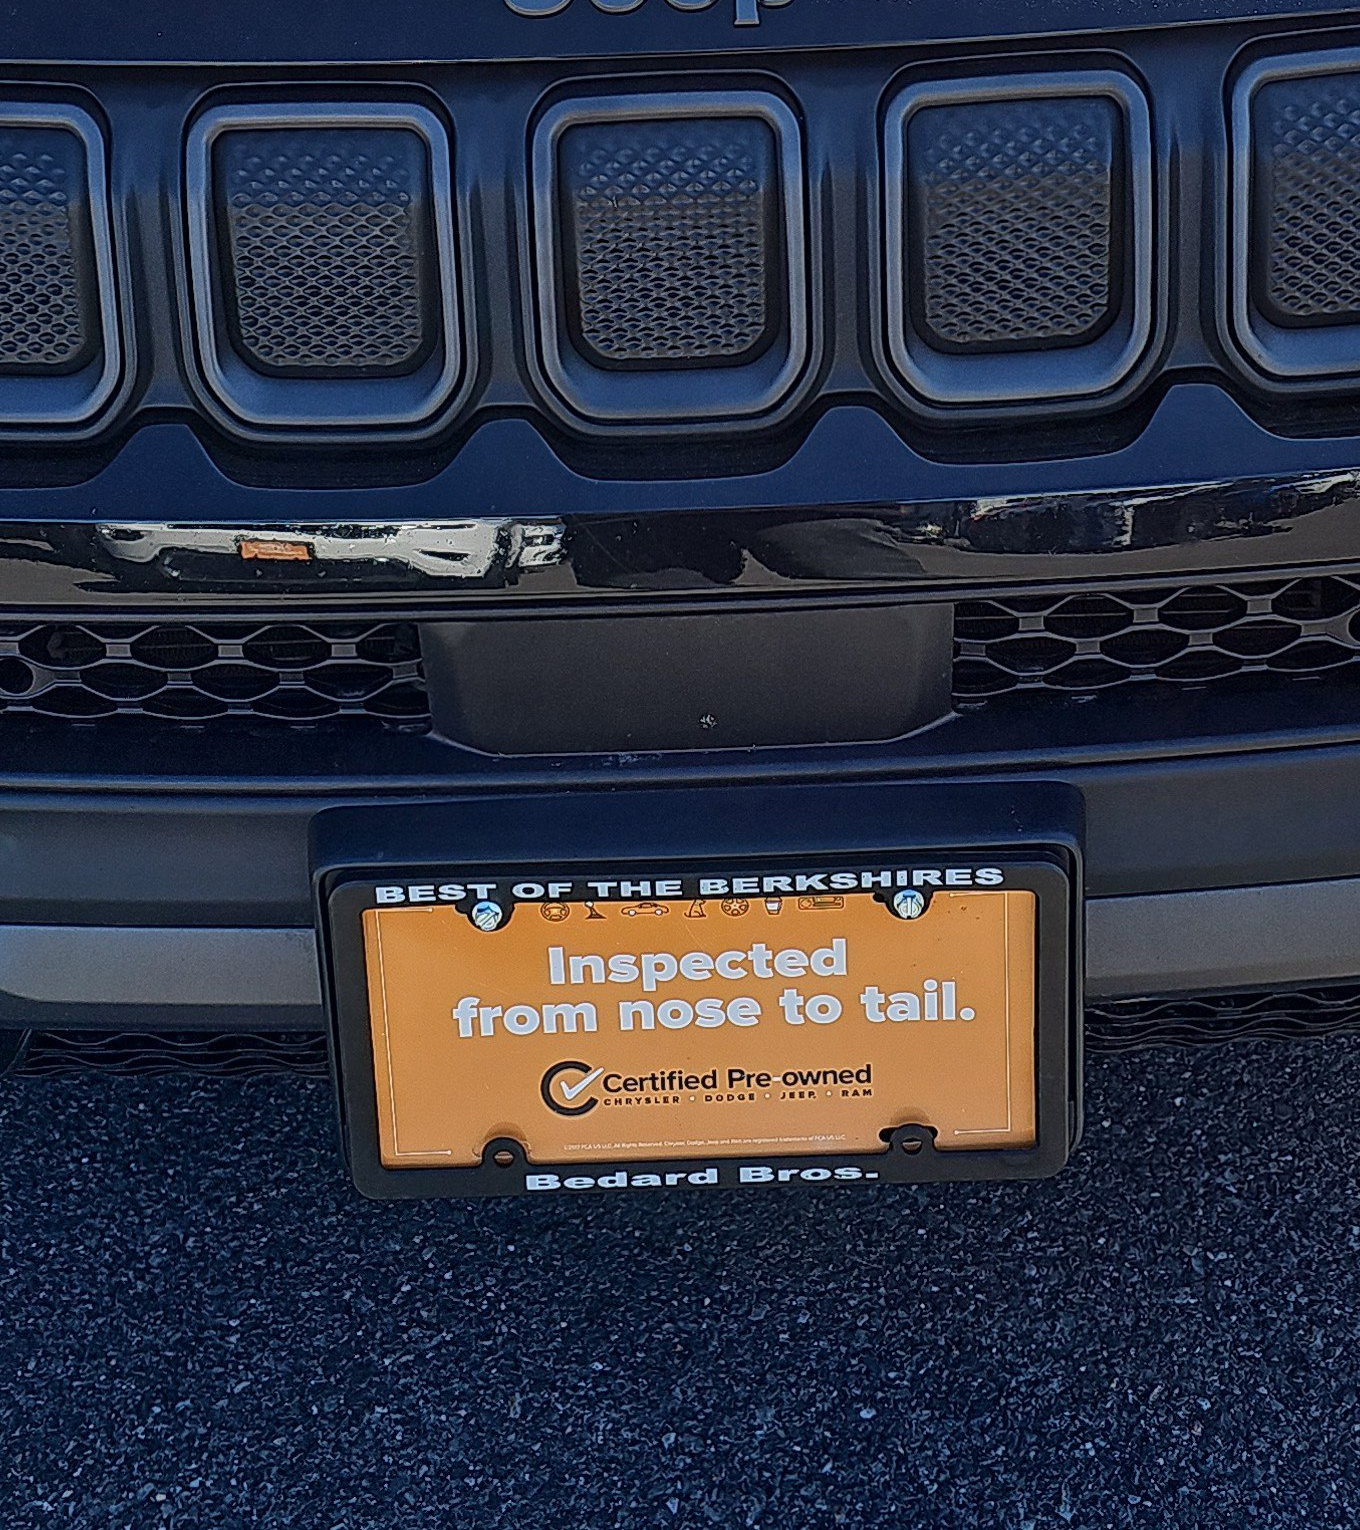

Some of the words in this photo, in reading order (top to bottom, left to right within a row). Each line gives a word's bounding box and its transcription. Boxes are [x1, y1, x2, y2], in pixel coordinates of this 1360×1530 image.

[375, 883, 497, 904] BEST
[512, 881, 573, 899] OF
[588, 879, 683, 898] THE
[699, 867, 1005, 895] BERKSHIRES
[547, 937, 847, 992] Inspected
[452, 996, 598, 1038] from
[618, 997, 761, 1031] nose
[779, 987, 843, 1026] to
[859, 978, 976, 1024] tail.
[602, 1068, 717, 1094] Certified
[727, 1063, 873, 1089] Pre-owned
[603, 1095, 680, 1106] CHRYSLER
[704, 1092, 756, 1102] DODGE
[841, 1088, 873, 1097] RAM
[525, 1167, 719, 1191] Bedard
[738, 1165, 880, 1184] Bros.
